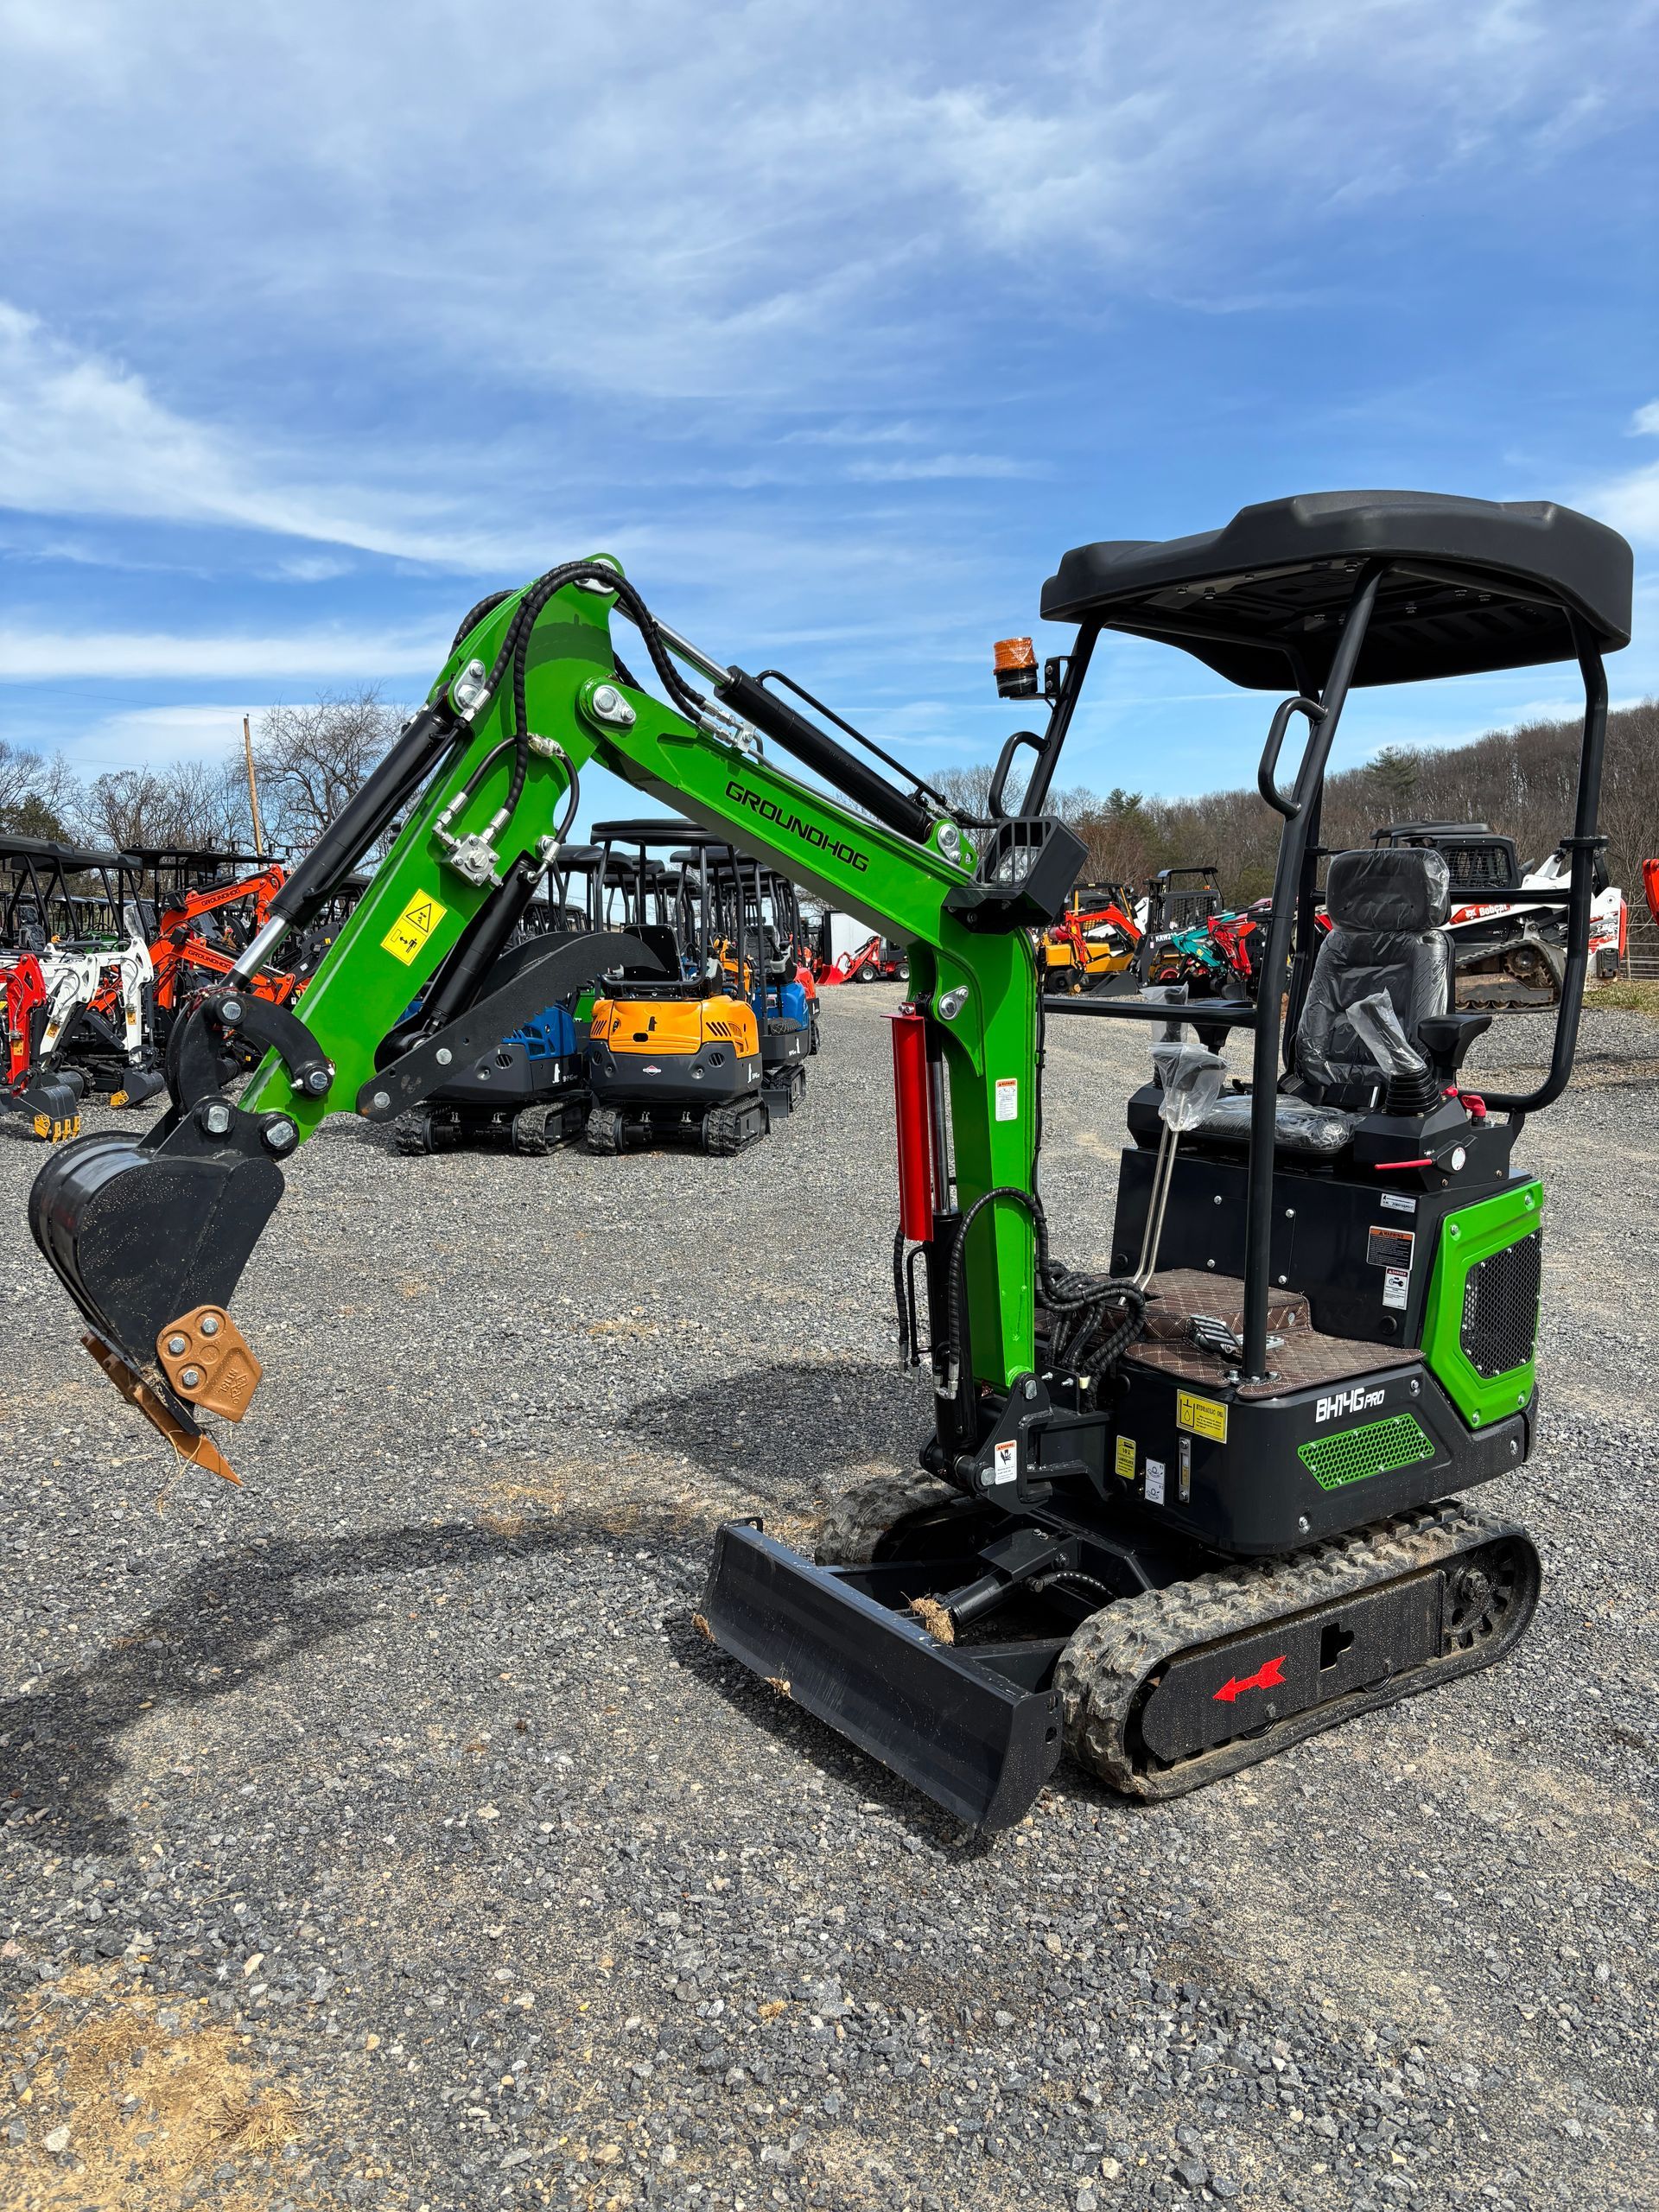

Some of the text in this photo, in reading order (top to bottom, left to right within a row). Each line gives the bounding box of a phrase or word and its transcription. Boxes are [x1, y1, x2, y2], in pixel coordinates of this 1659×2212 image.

[725, 780, 870, 873] GROUNDHOG
[200, 888, 241, 906] GROUNDHOG
[1478, 904, 1508, 917] Bobcat
[188, 950, 232, 969] GROUNDHOG
[1383, 1230, 1405, 1239] WARNING
[1315, 1387, 1385, 1424] BH14G PRO
